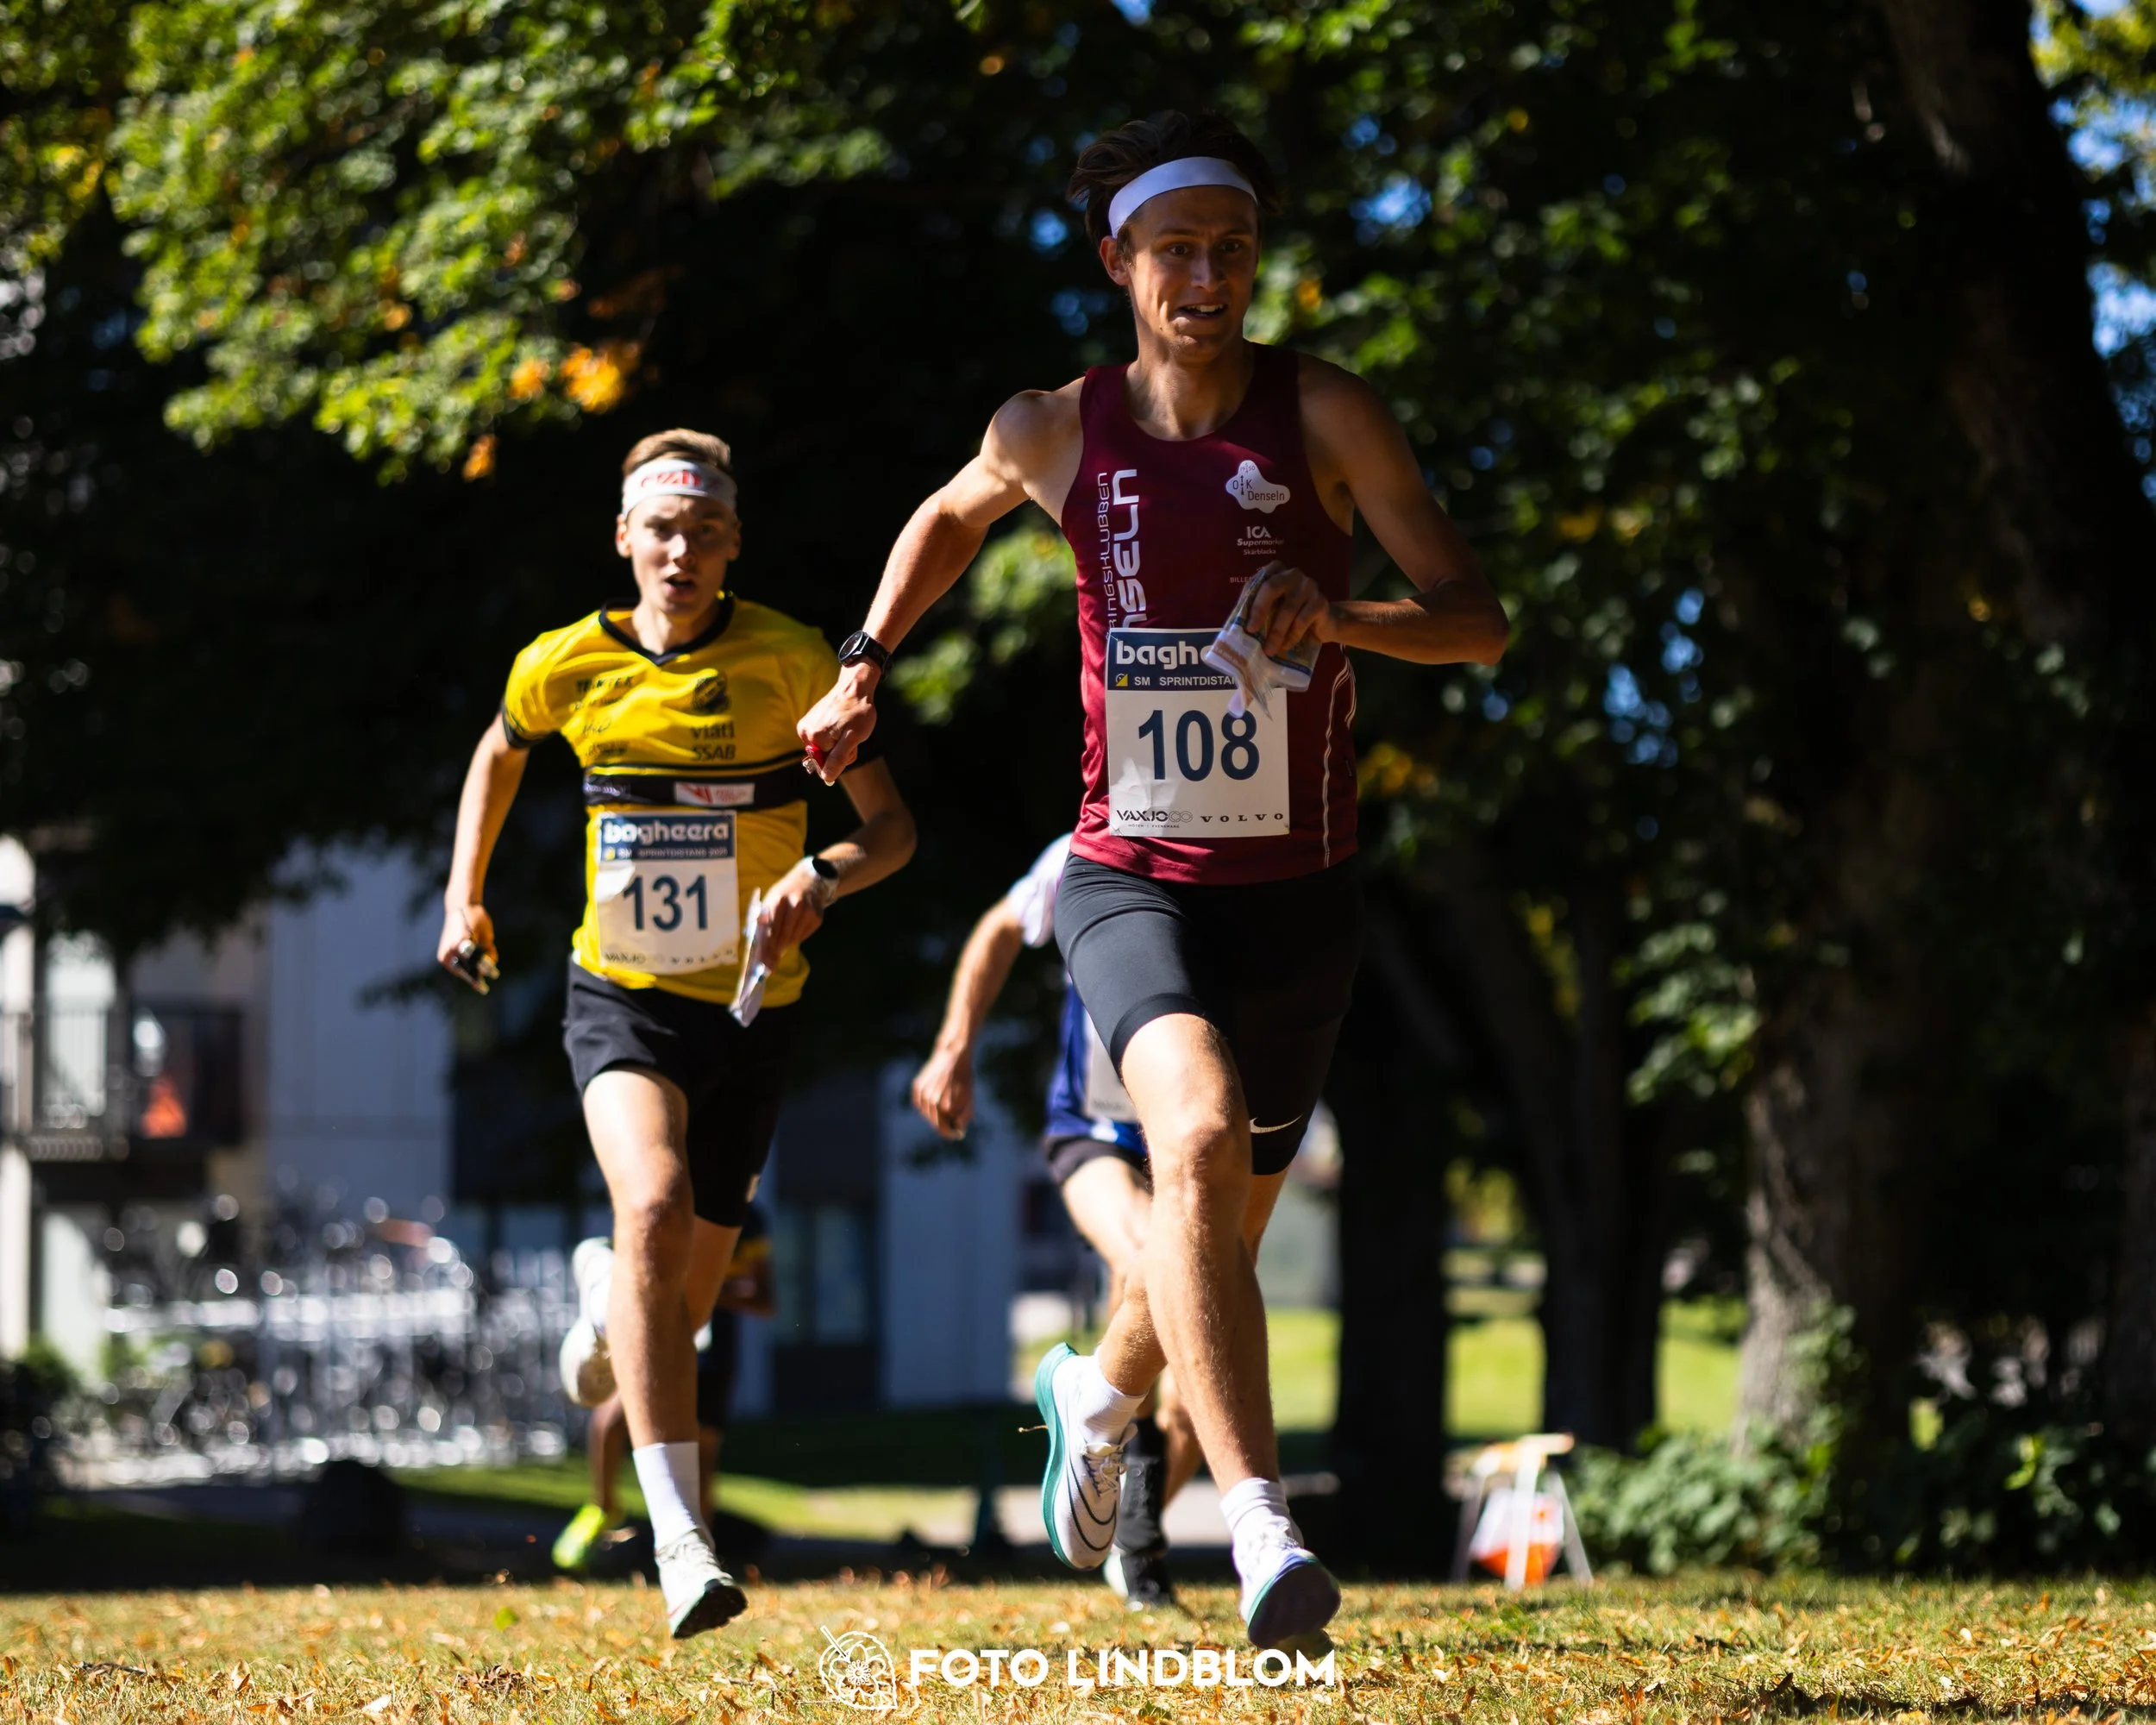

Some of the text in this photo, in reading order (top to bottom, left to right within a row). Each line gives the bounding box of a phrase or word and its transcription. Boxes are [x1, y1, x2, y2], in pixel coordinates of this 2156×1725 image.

[1247, 490, 1285, 501] Denseln
[1246, 526, 1271, 539] ICA
[1237, 538, 1284, 547] Supermarket
[1134, 676, 1150, 686] SM
[1138, 710, 1260, 781] 108
[1200, 813, 1284, 824] VOLVO
[604, 820, 730, 845] bagheera
[623, 874, 708, 932] 131
